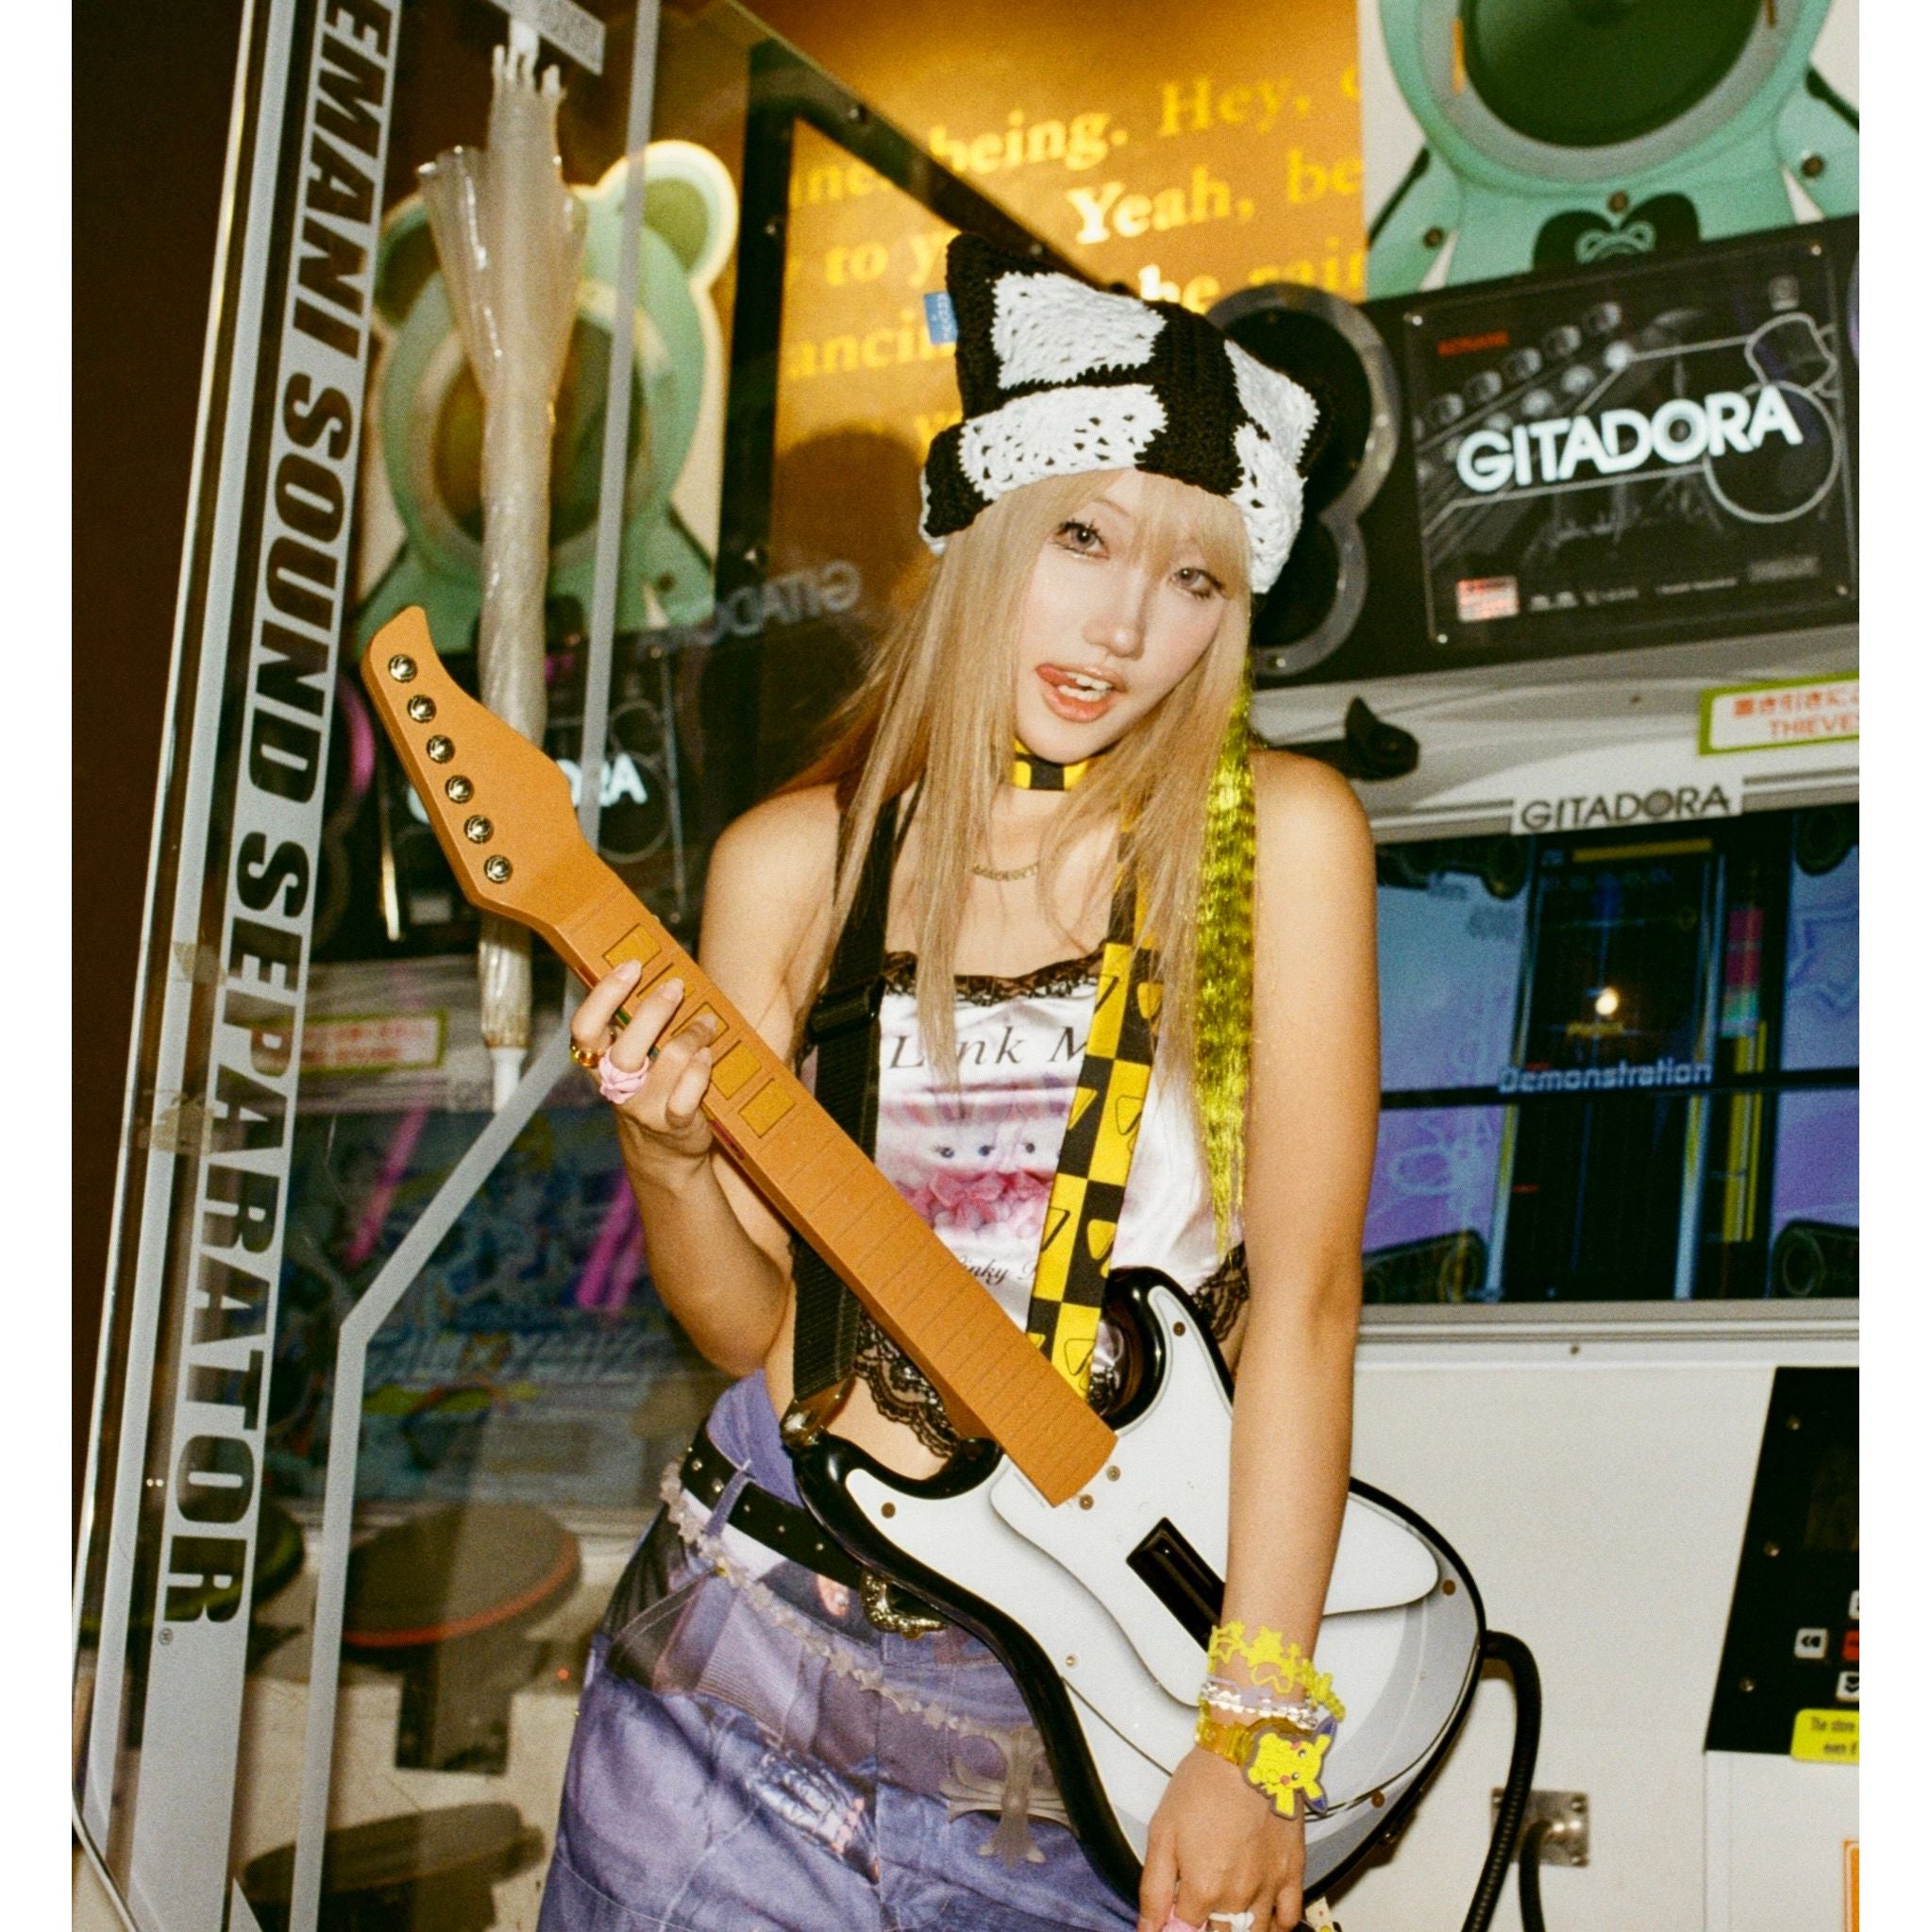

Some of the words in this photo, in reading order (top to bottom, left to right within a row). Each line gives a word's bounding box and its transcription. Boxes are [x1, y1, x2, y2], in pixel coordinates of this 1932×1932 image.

[929, 109, 1129, 175] being.
[1159, 74, 1311, 137] Hey,
[824, 241, 889, 287] to
[1066, 162, 1254, 245] Yeah,
[1456, 385, 1803, 493] GITADORA
[248, 372, 352, 803] SOUND
[1521, 784, 1729, 832] GITADORA
[888, 1026, 1023, 1069] Lnk
[1499, 1057, 1713, 1095] Demonstration
[163, 832, 310, 1623] SEPARATOR
